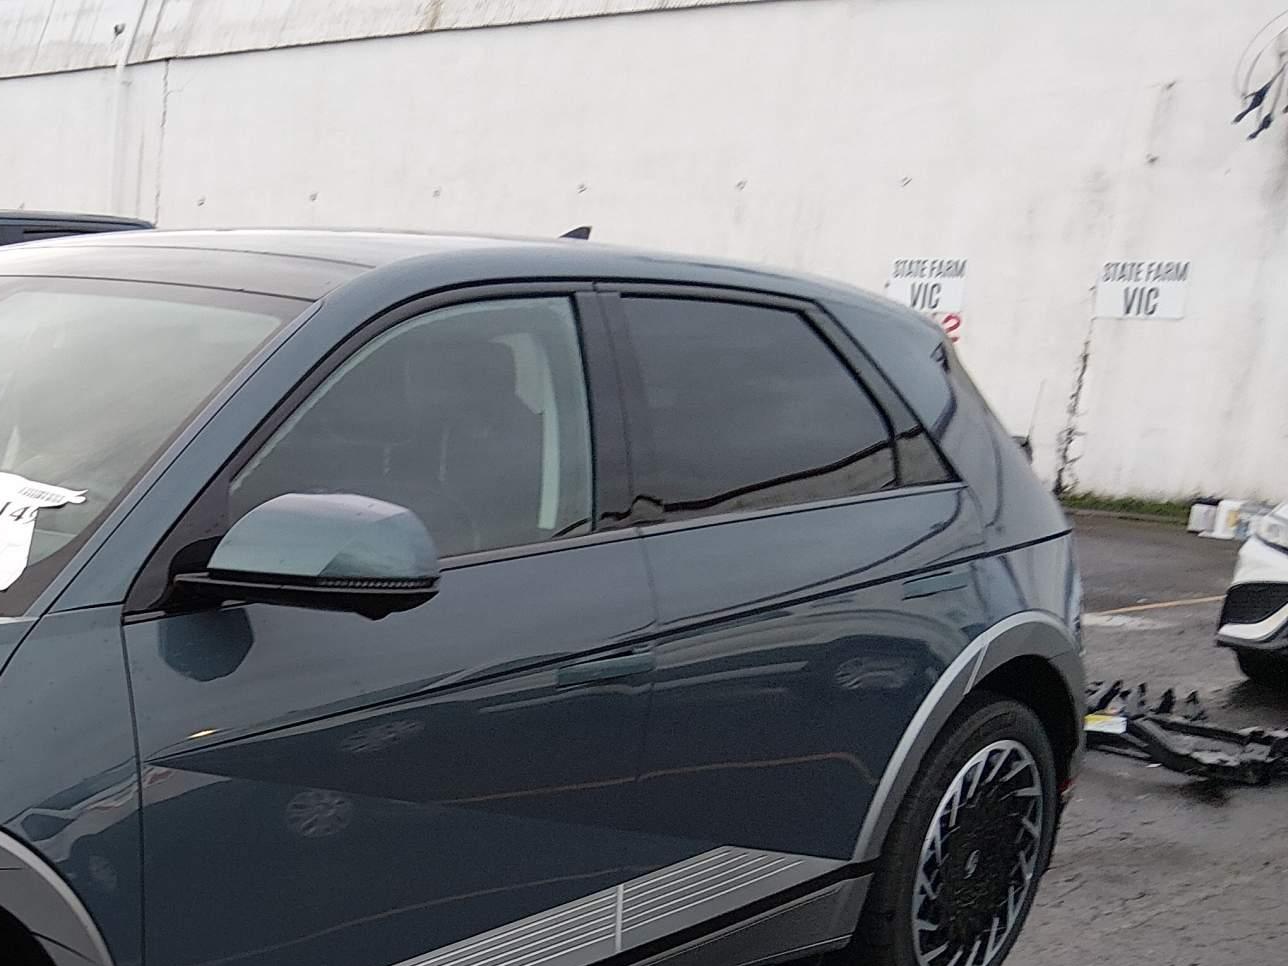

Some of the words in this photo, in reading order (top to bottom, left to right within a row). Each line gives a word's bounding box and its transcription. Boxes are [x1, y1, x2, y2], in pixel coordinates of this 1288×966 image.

[892, 258, 928, 279] STATE
[928, 258, 968, 279] FARM
[1102, 261, 1144, 282] STATE
[1144, 261, 1191, 282] FARM
[910, 282, 942, 309] VIC
[1122, 285, 1160, 316] VIC
